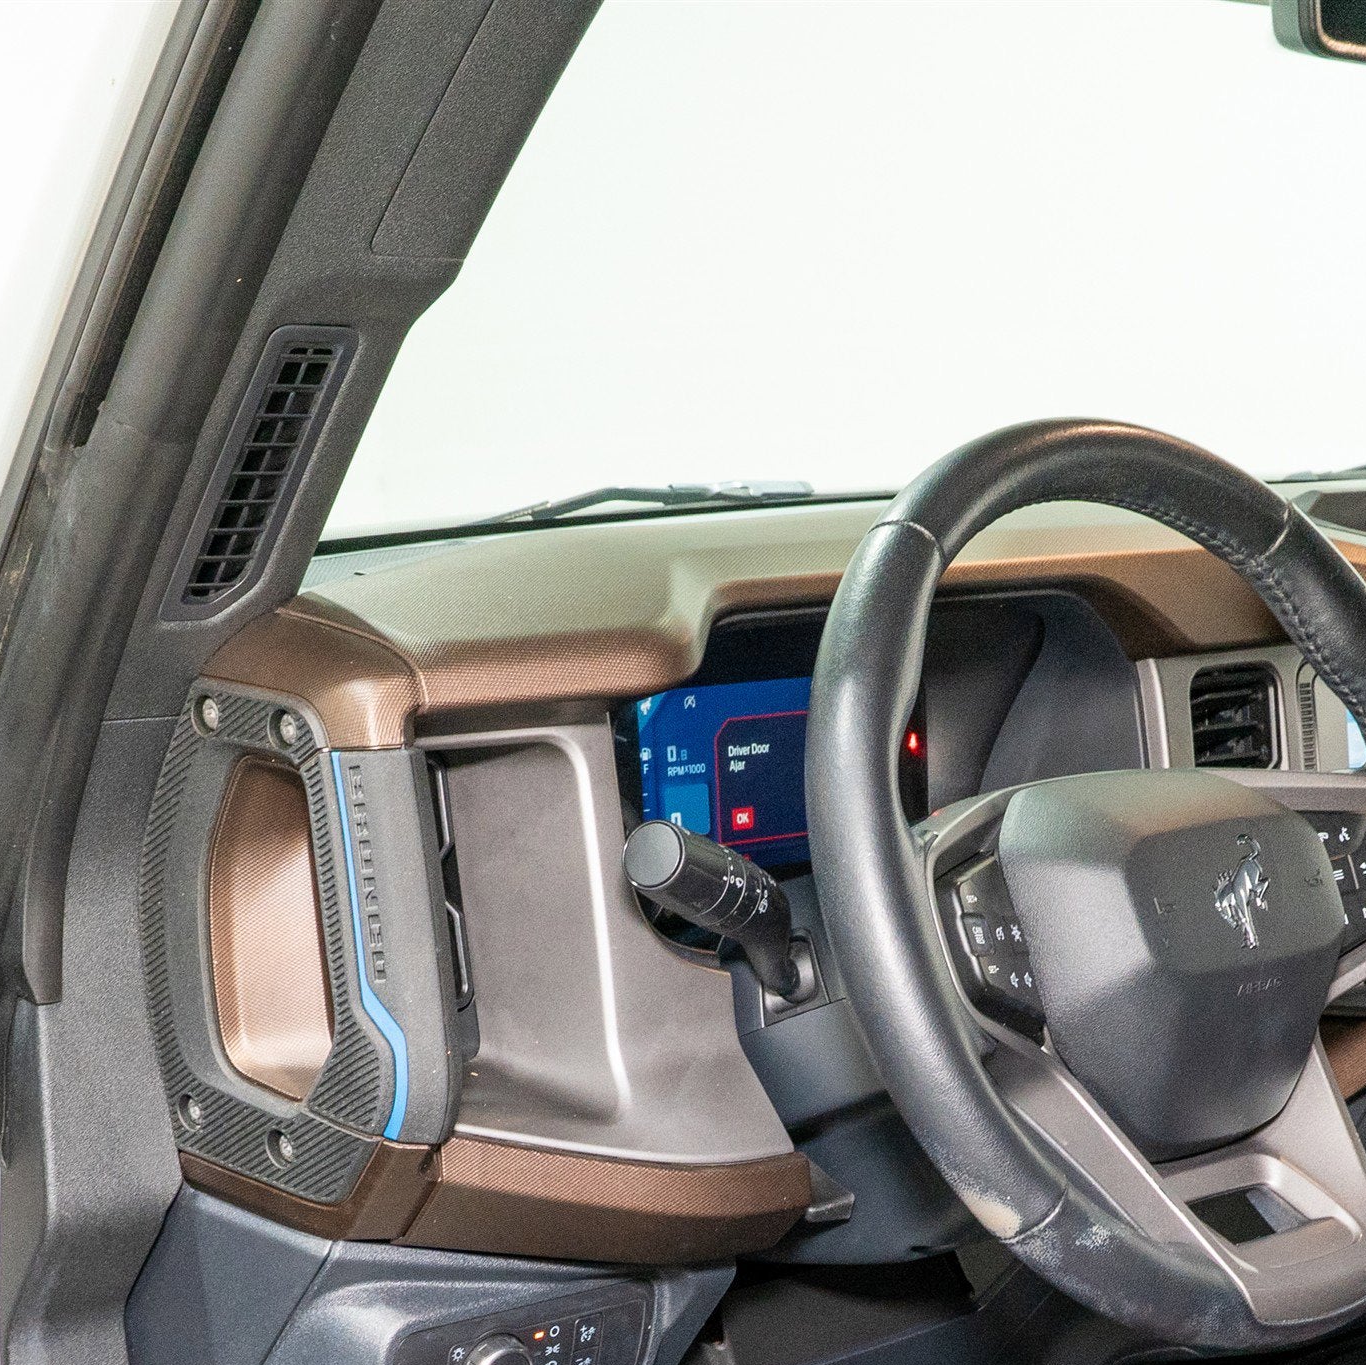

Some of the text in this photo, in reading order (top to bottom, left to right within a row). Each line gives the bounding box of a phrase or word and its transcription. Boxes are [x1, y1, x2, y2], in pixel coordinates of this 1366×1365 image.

[727, 742, 770, 757] Driver Door
[643, 763, 649, 775] F
[729, 759, 746, 773] Ajar
[736, 811, 750, 825] OK
[348, 765, 386, 984] BRONCO
